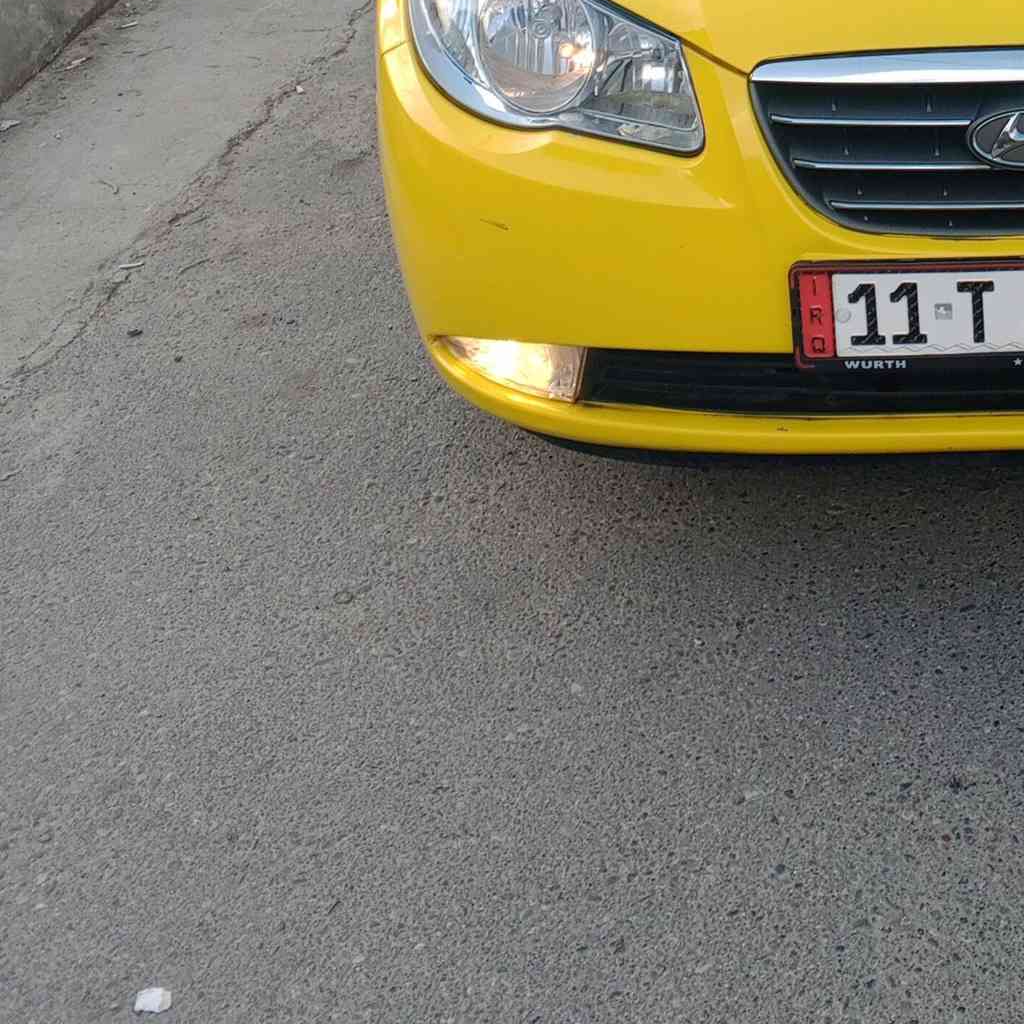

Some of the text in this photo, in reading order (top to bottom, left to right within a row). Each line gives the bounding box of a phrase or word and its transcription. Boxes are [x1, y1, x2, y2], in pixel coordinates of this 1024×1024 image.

[847, 281, 928, 346] 11
[956, 280, 995, 343] T
[844, 359, 907, 369] WURTH
